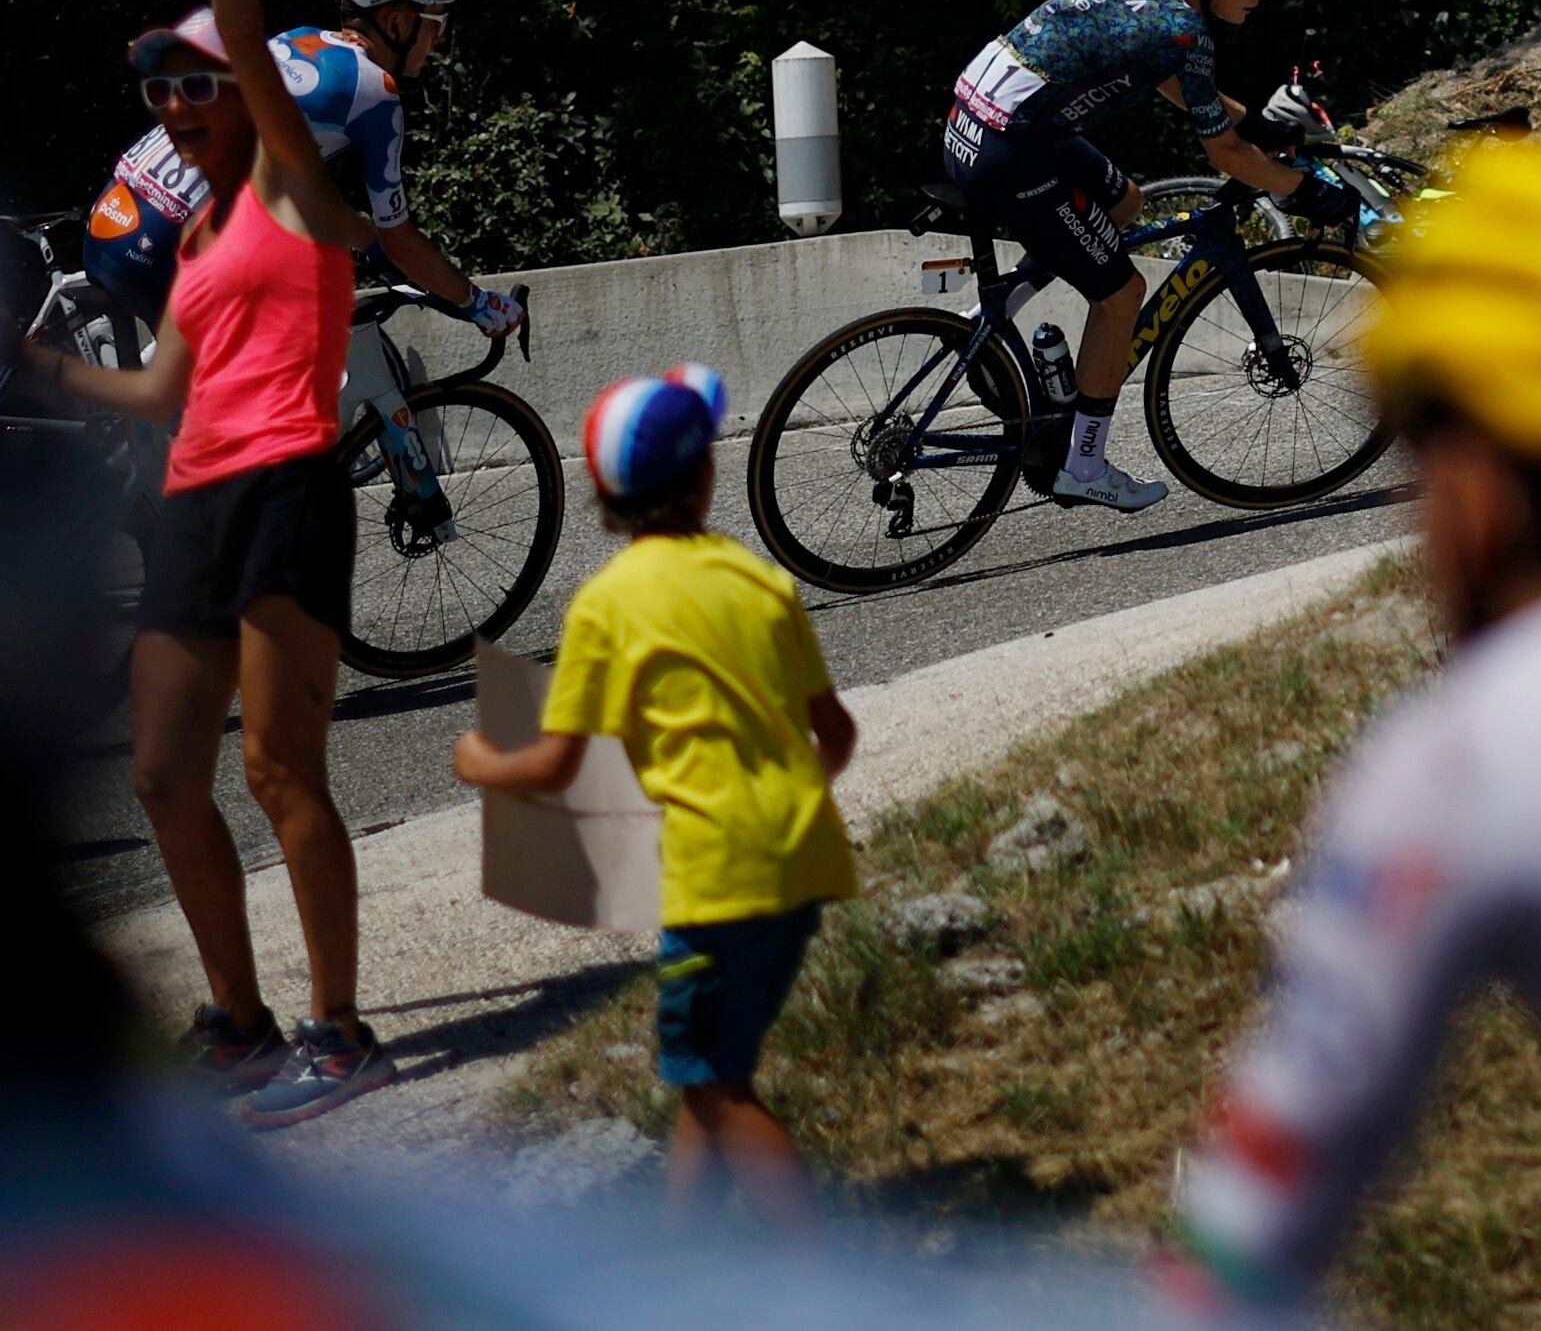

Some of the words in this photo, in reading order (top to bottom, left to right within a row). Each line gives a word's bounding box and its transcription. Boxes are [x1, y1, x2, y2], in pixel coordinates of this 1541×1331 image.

[984, 65, 1021, 102] 1
[1060, 73, 1134, 123] BETCITY
[956, 109, 985, 146] VISMA
[1088, 201, 1120, 253] VISMA
[937, 271, 949, 294] 1
[829, 323, 896, 360] RESERVE
[1079, 420, 1101, 458] nimbl
[955, 452, 999, 466] SRAM
[1085, 486, 1120, 504] nimbl
